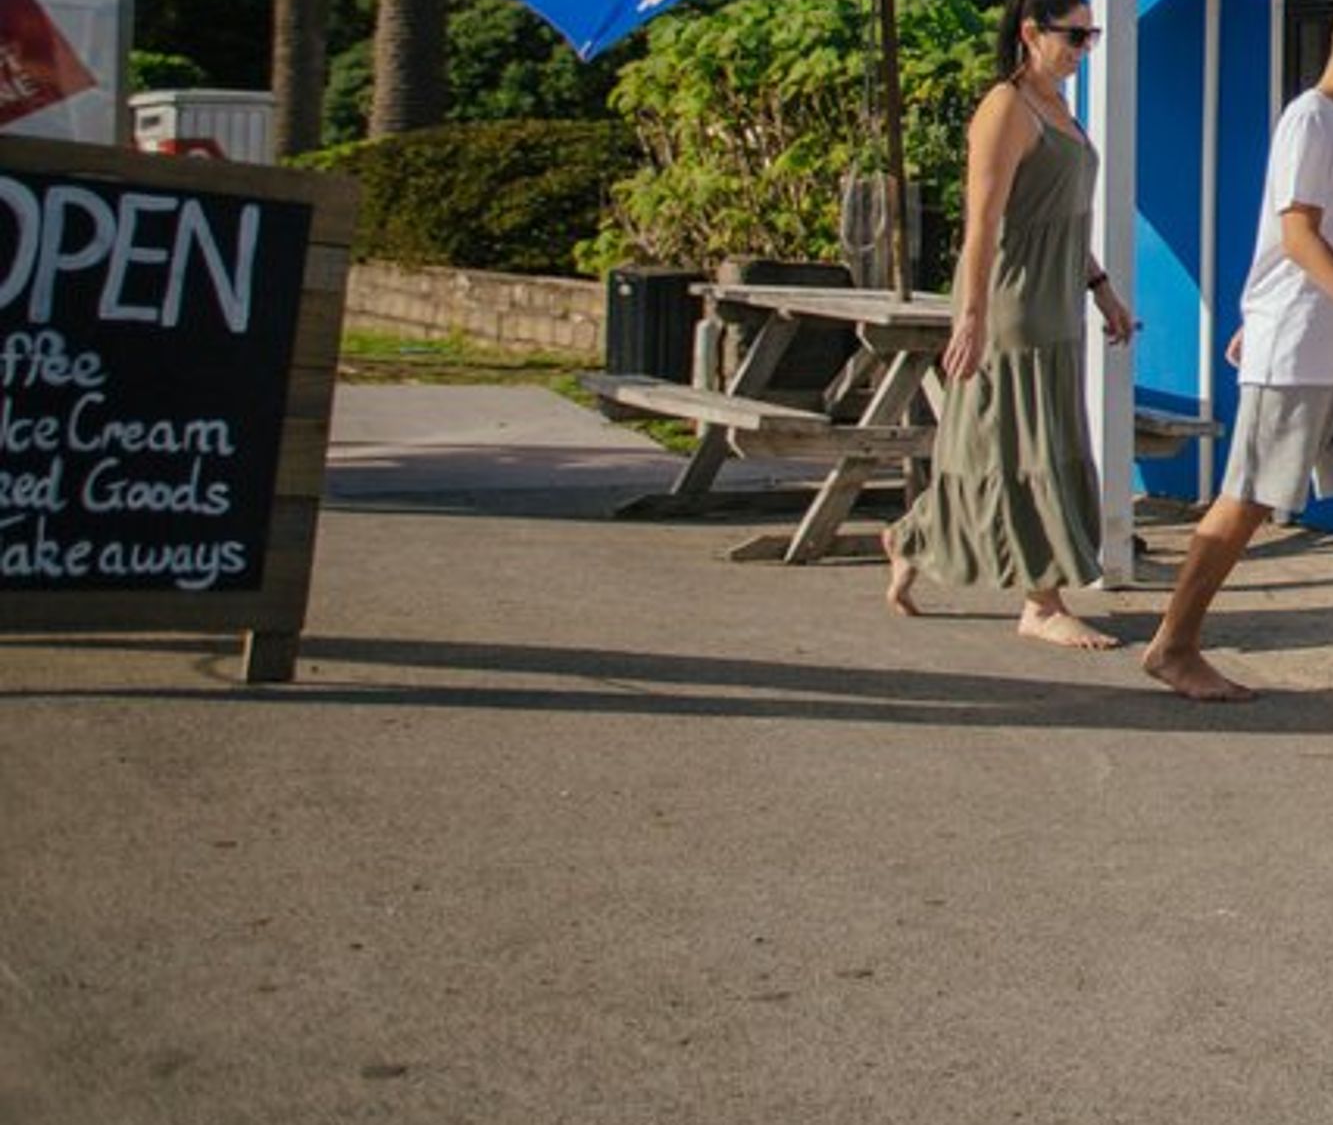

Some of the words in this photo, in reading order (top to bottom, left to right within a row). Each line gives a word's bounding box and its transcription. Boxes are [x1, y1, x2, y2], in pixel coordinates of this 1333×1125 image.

[0, 330, 107, 387] ffee
[68, 391, 236, 456] Cream
[82, 456, 231, 516] Goods
